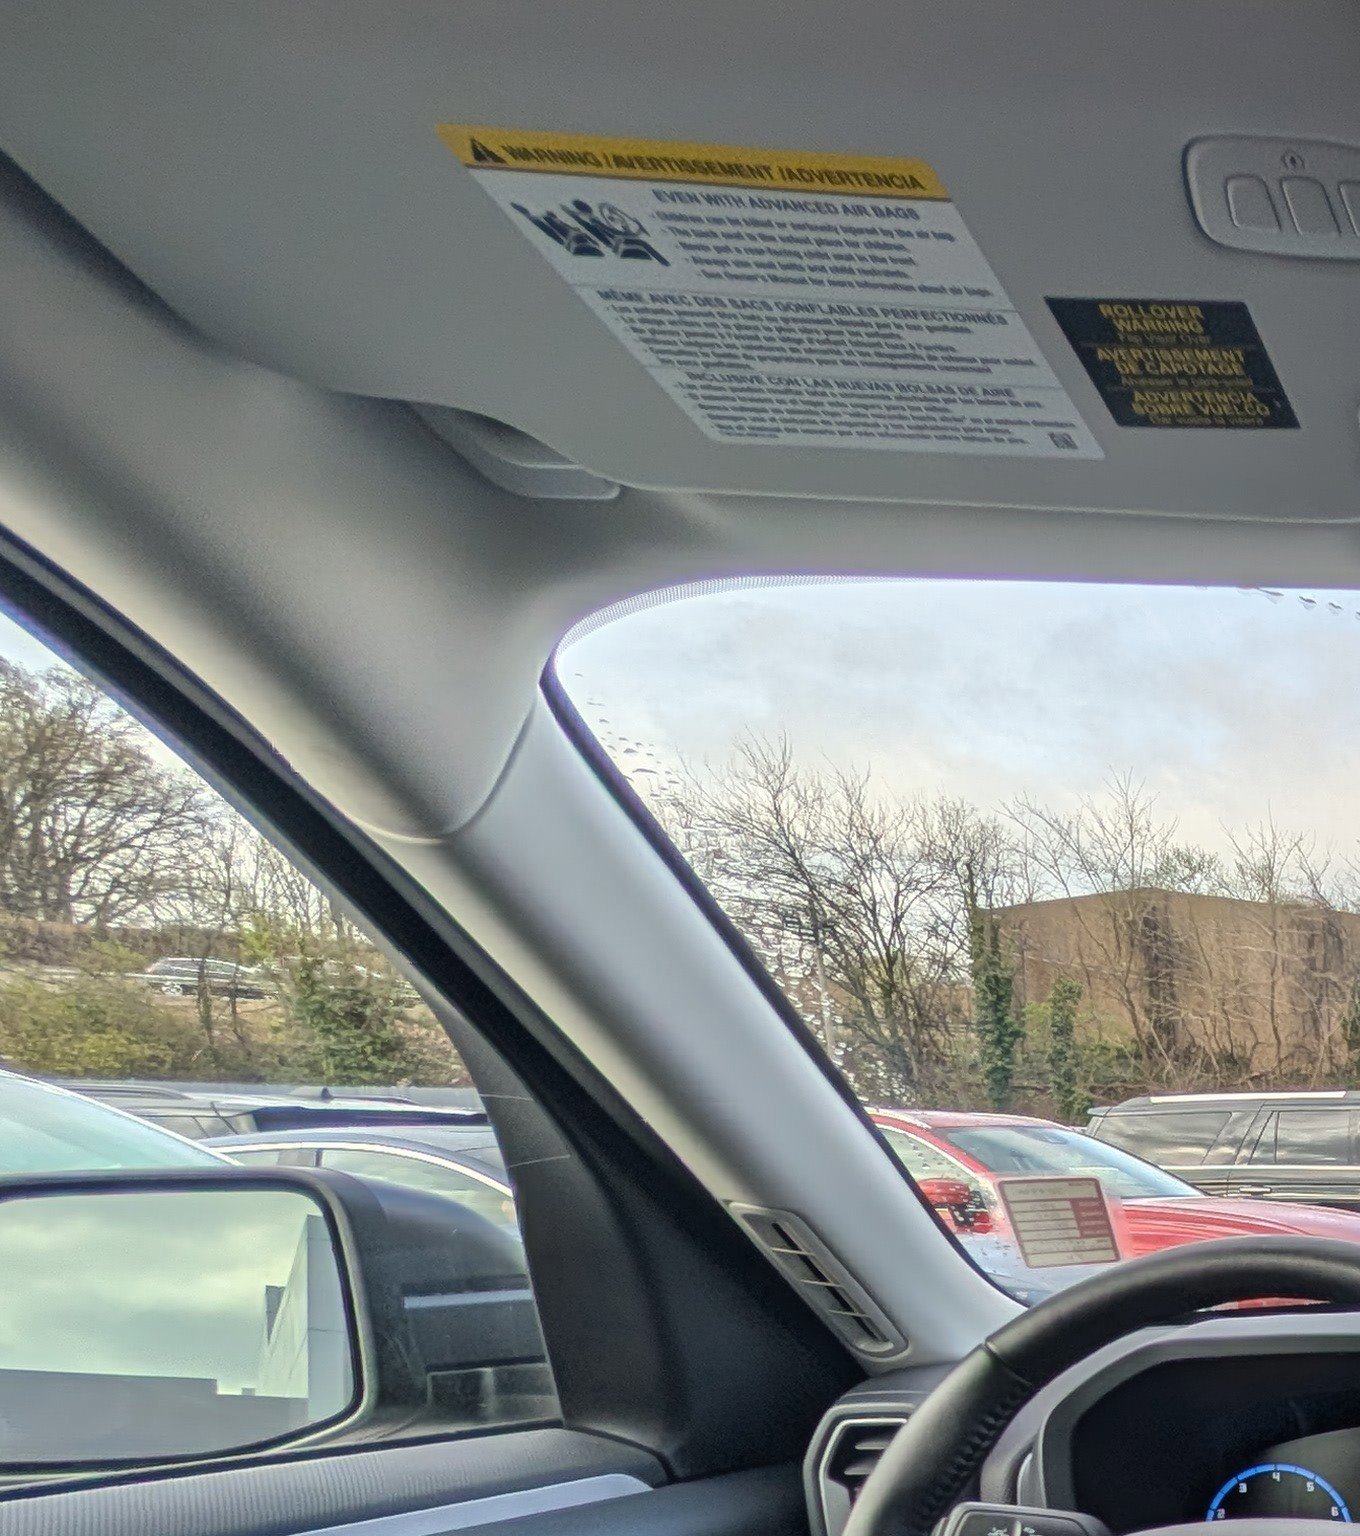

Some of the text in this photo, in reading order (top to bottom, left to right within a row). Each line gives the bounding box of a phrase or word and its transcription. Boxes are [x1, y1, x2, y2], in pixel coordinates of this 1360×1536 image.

[502, 146, 603, 166] WARNING
[652, 190, 920, 220] EVEN WITH ADVANCED AIR BAGS
[1100, 304, 1201, 317] ROLLOVER
[1114, 319, 1202, 332] WARNING
